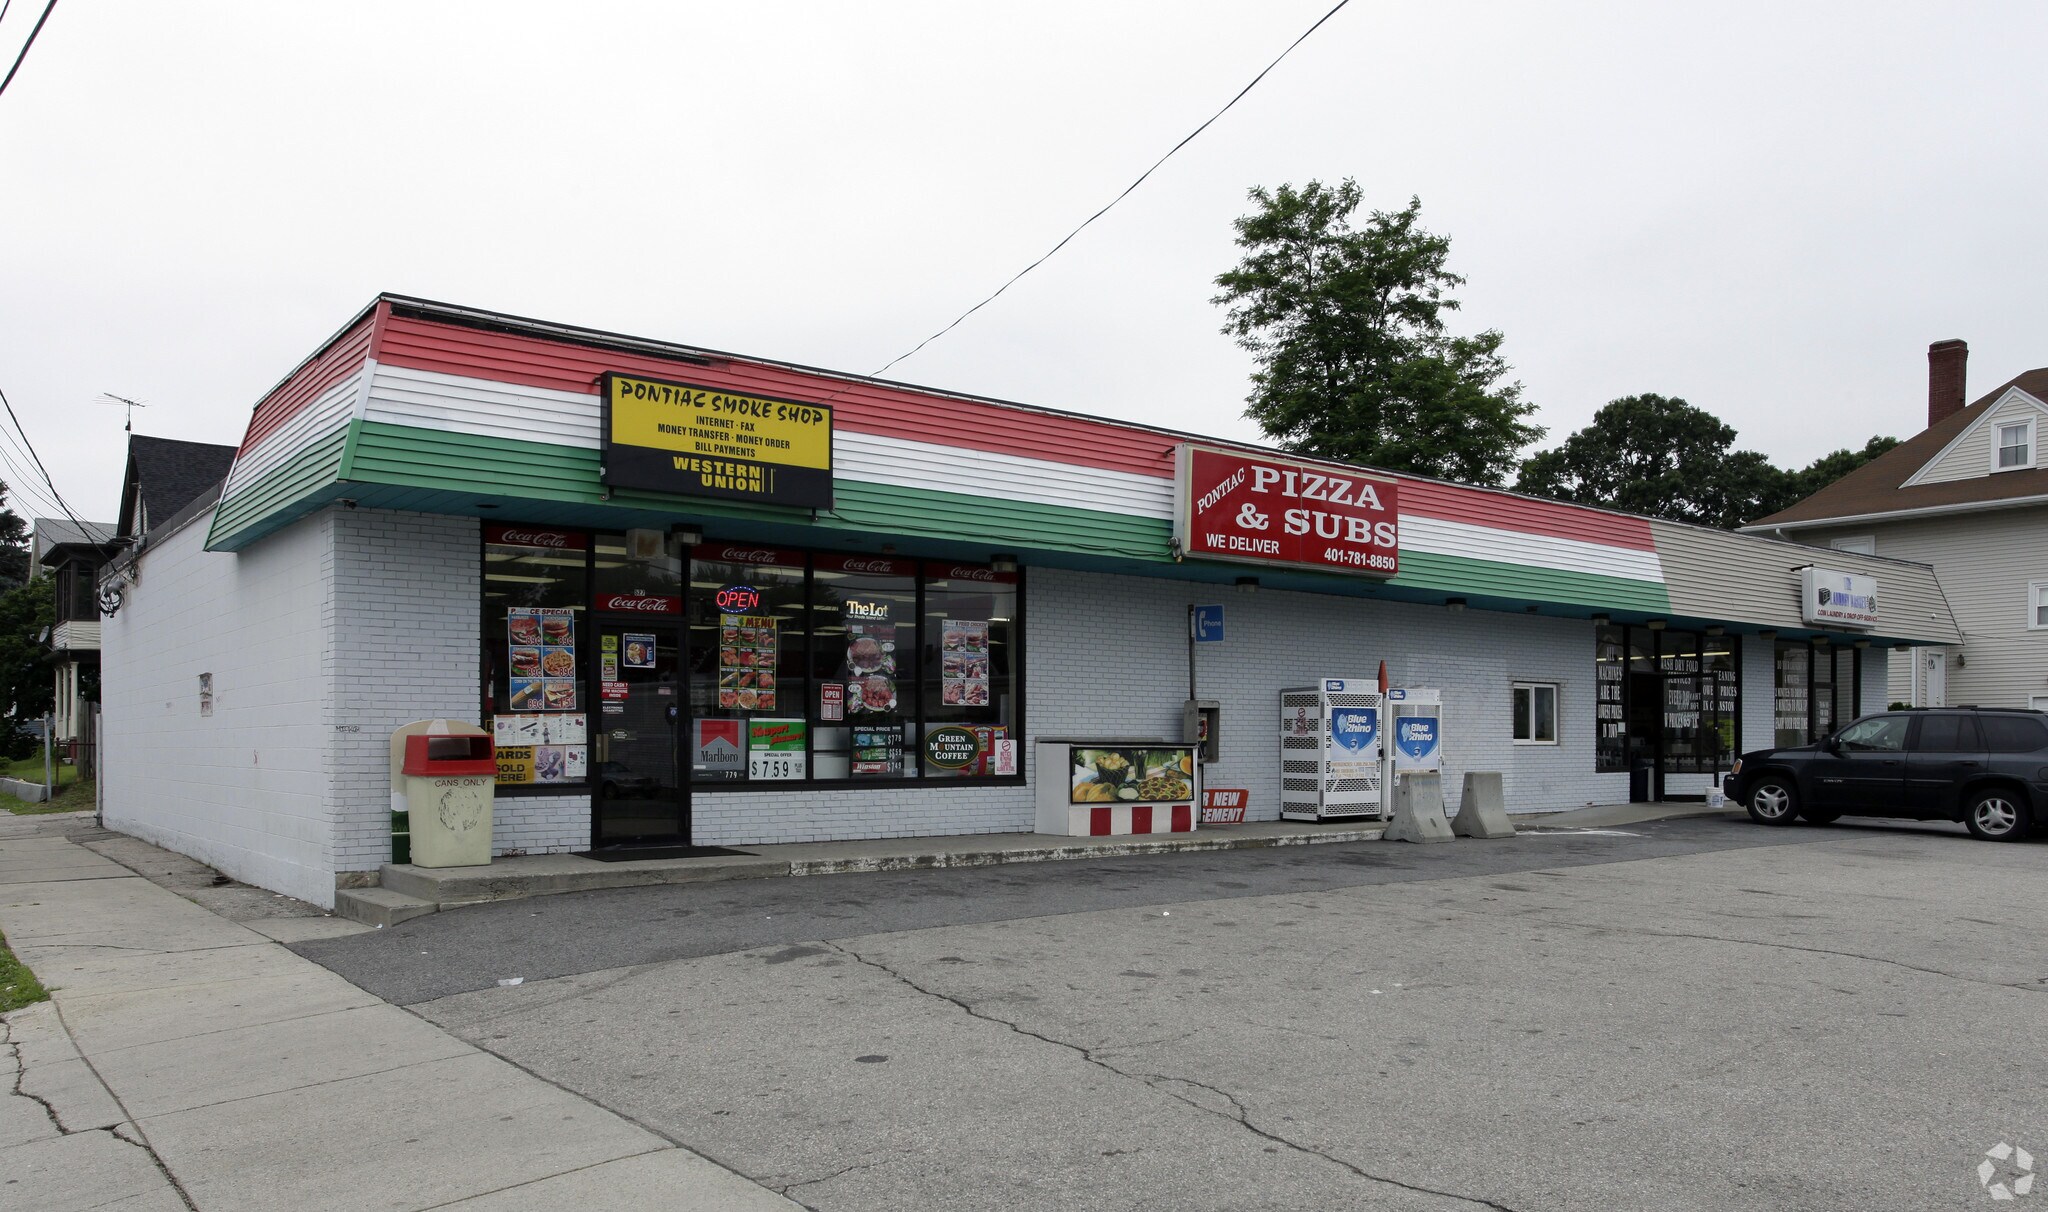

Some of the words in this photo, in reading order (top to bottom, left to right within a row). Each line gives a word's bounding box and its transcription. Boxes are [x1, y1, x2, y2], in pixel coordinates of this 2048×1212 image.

[621, 381, 706, 408] PONTIAC
[712, 396, 772, 418] SMOKE
[777, 405, 823, 426] SHOP
[696, 416, 734, 428] INTERNET
[741, 422, 755, 432] FAX
[658, 423, 686, 436] MONEY
[688, 427, 729, 441] TRANSFER
[736, 434, 763, 446] MONEY
[765, 438, 790, 449] ORDER
[695, 442, 712, 452] BILL
[714, 444, 756, 457] PAYMENTS
[673, 456, 761, 479] WESTERN
[701, 474, 761, 493] UNION
[1250, 466, 1384, 511] PIZZA
[1196, 467, 1245, 515] PONTIAC
[1236, 503, 1268, 530] &
[1284, 508, 1396, 548] SUBS
[1206, 533, 1225, 549] WE
[1229, 536, 1280, 554] DELIVER
[1324, 548, 1395, 570] 401-781-8850
[716, 590, 760, 608] OPEN
[746, 618, 774, 628] MENU
[1675, 659, 1684, 671] DRY
[1686, 660, 1698, 672] FOLD
[1721, 685, 1737, 697] PRICES
[1348, 714, 1367, 724] Blue
[1345, 723, 1371, 733] Rhino
[1411, 723, 1428, 732] Blue
[938, 734, 966, 742] GREEN
[1409, 732, 1432, 741] Rhino
[496, 751, 531, 759] ARDS
[700, 748, 738, 762] Marlboro
[935, 752, 967, 760] COFFEE
[463, 778, 487, 787] ONLY
[1213, 792, 1240, 806] NEW
[1203, 808, 1243, 822] EMENT
